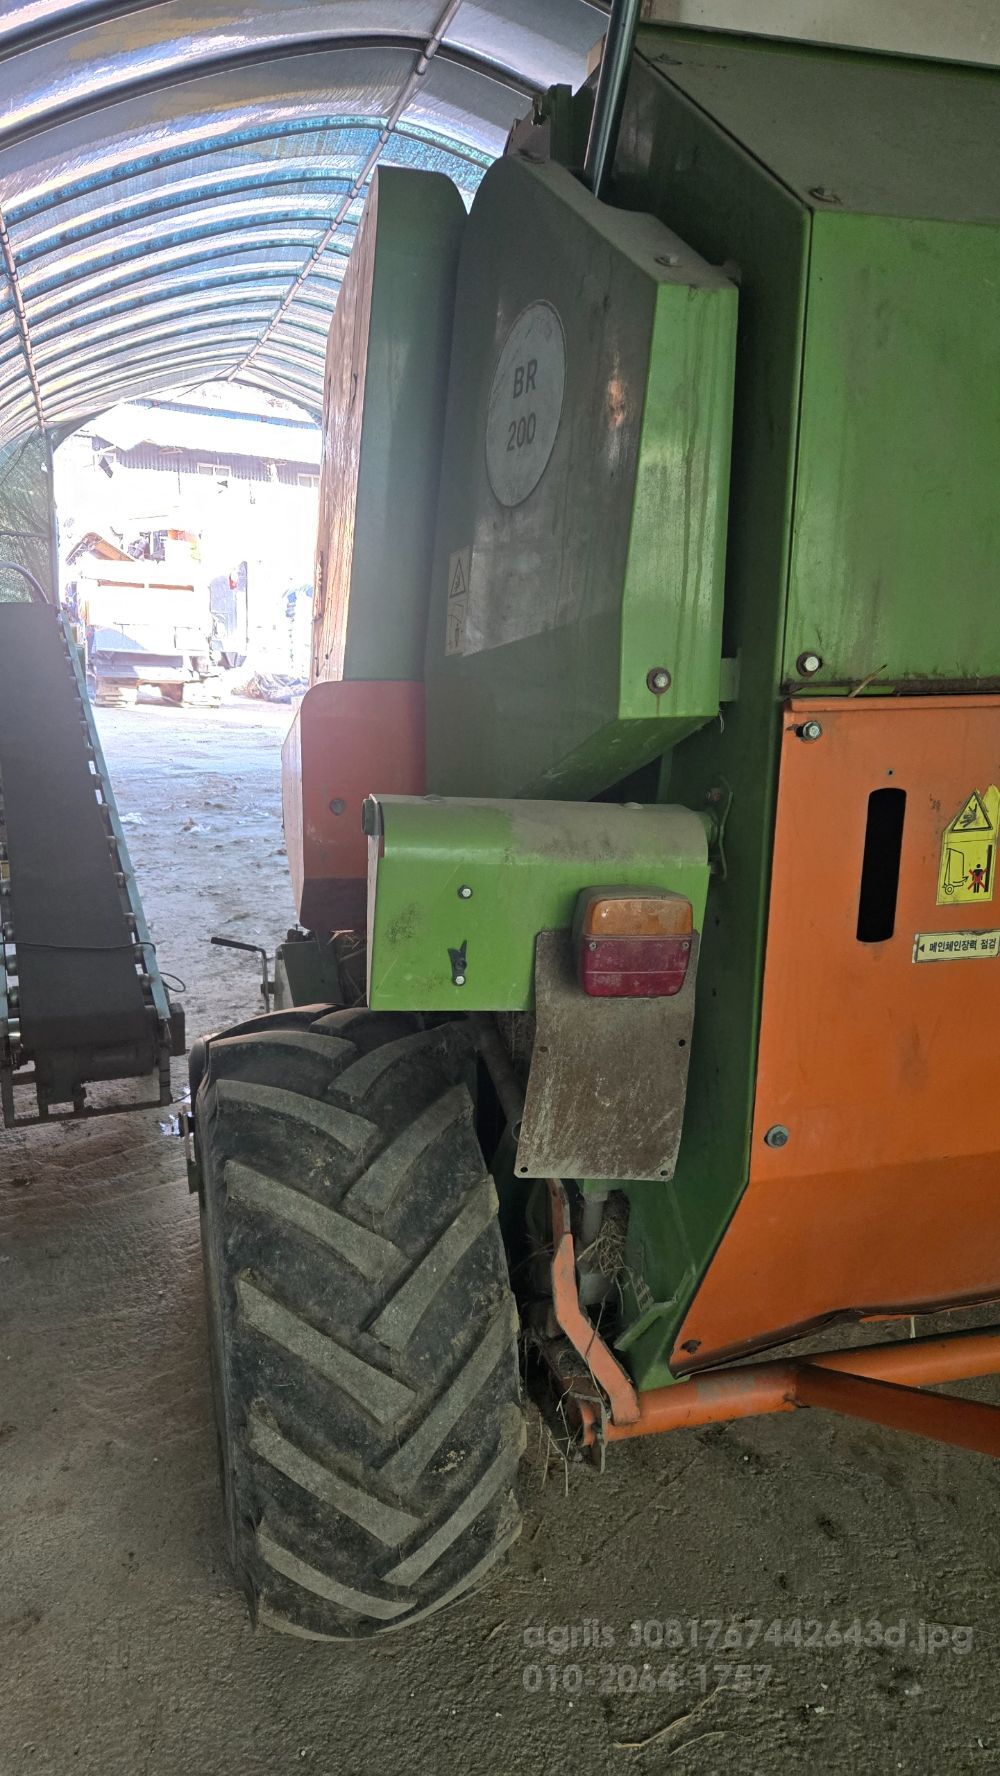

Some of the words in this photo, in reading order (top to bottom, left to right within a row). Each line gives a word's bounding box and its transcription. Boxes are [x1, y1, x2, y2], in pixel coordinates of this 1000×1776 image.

[513, 358, 538, 399] BR
[506, 412, 536, 452] 200
[980, 938, 996, 950] 점검
